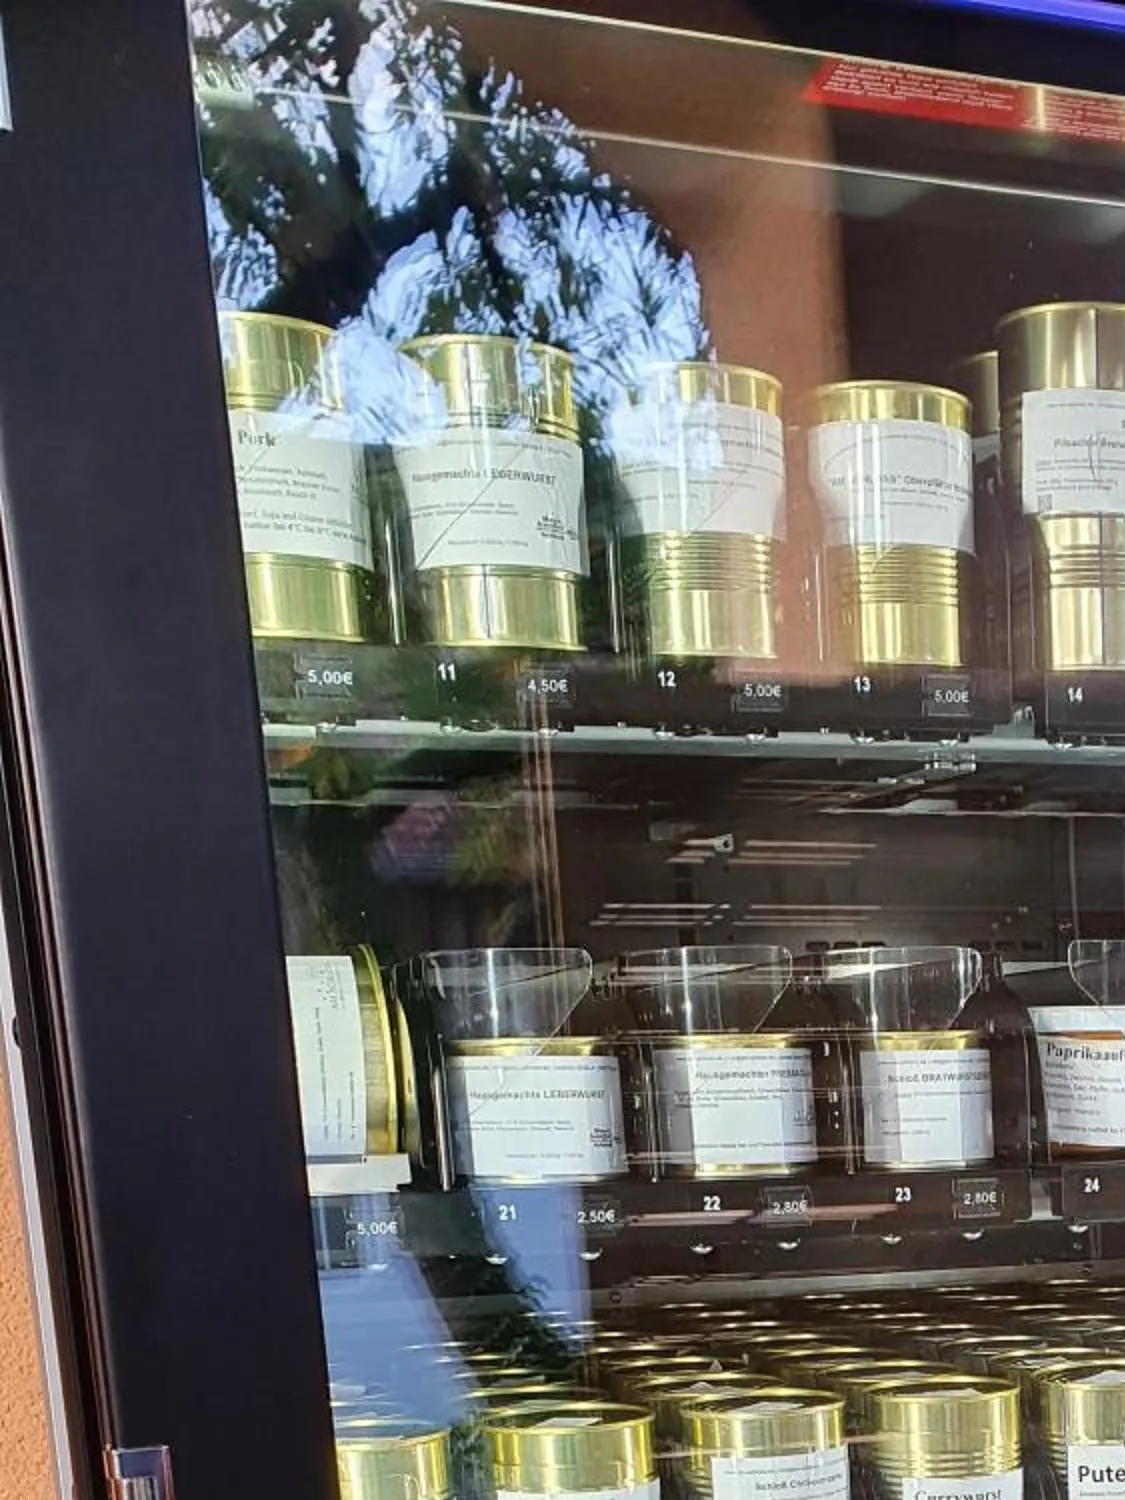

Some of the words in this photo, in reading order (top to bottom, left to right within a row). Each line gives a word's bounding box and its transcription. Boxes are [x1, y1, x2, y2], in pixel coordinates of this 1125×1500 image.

[307, 669, 353, 686] 5,00€
[438, 663, 456, 681] 11
[657, 670, 676, 687] 12
[527, 679, 568, 694] 4,50€
[744, 683, 781, 698] 5,00€
[854, 676, 871, 692] 13
[934, 690, 969, 703] 5,00€
[1068, 687, 1083, 702] 14
[1084, 1177, 1100, 1193] 24
[703, 1195, 721, 1211] 22
[895, 1187, 912, 1203] 23
[499, 1204, 516, 1220] 21
[357, 1221, 398, 1237] 5,00€
